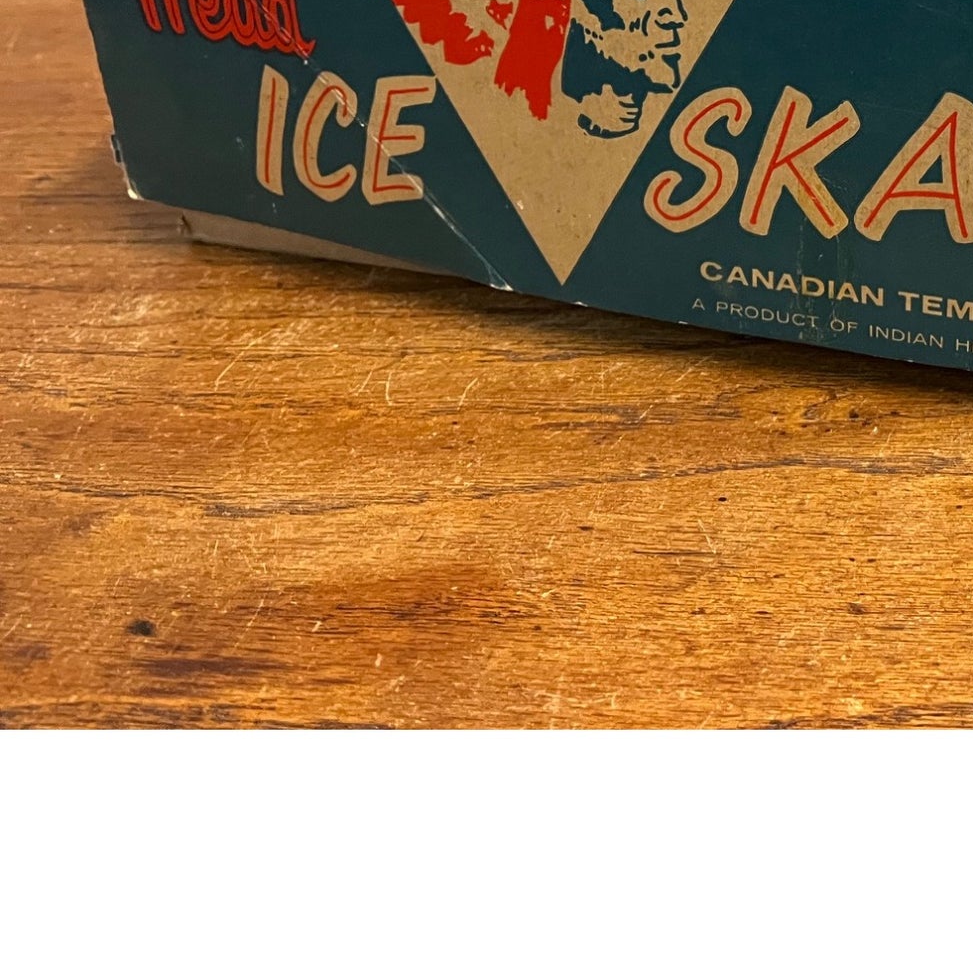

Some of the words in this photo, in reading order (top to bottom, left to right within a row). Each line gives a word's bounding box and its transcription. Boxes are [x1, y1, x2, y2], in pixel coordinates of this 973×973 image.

[255, 64, 436, 206] ICE
[699, 261, 885, 308] CANADIAN
[691, 298, 706, 312] A
[716, 301, 820, 329] PRODUCT
[830, 318, 859, 334] OF
[868, 325, 944, 350] INDIAN
